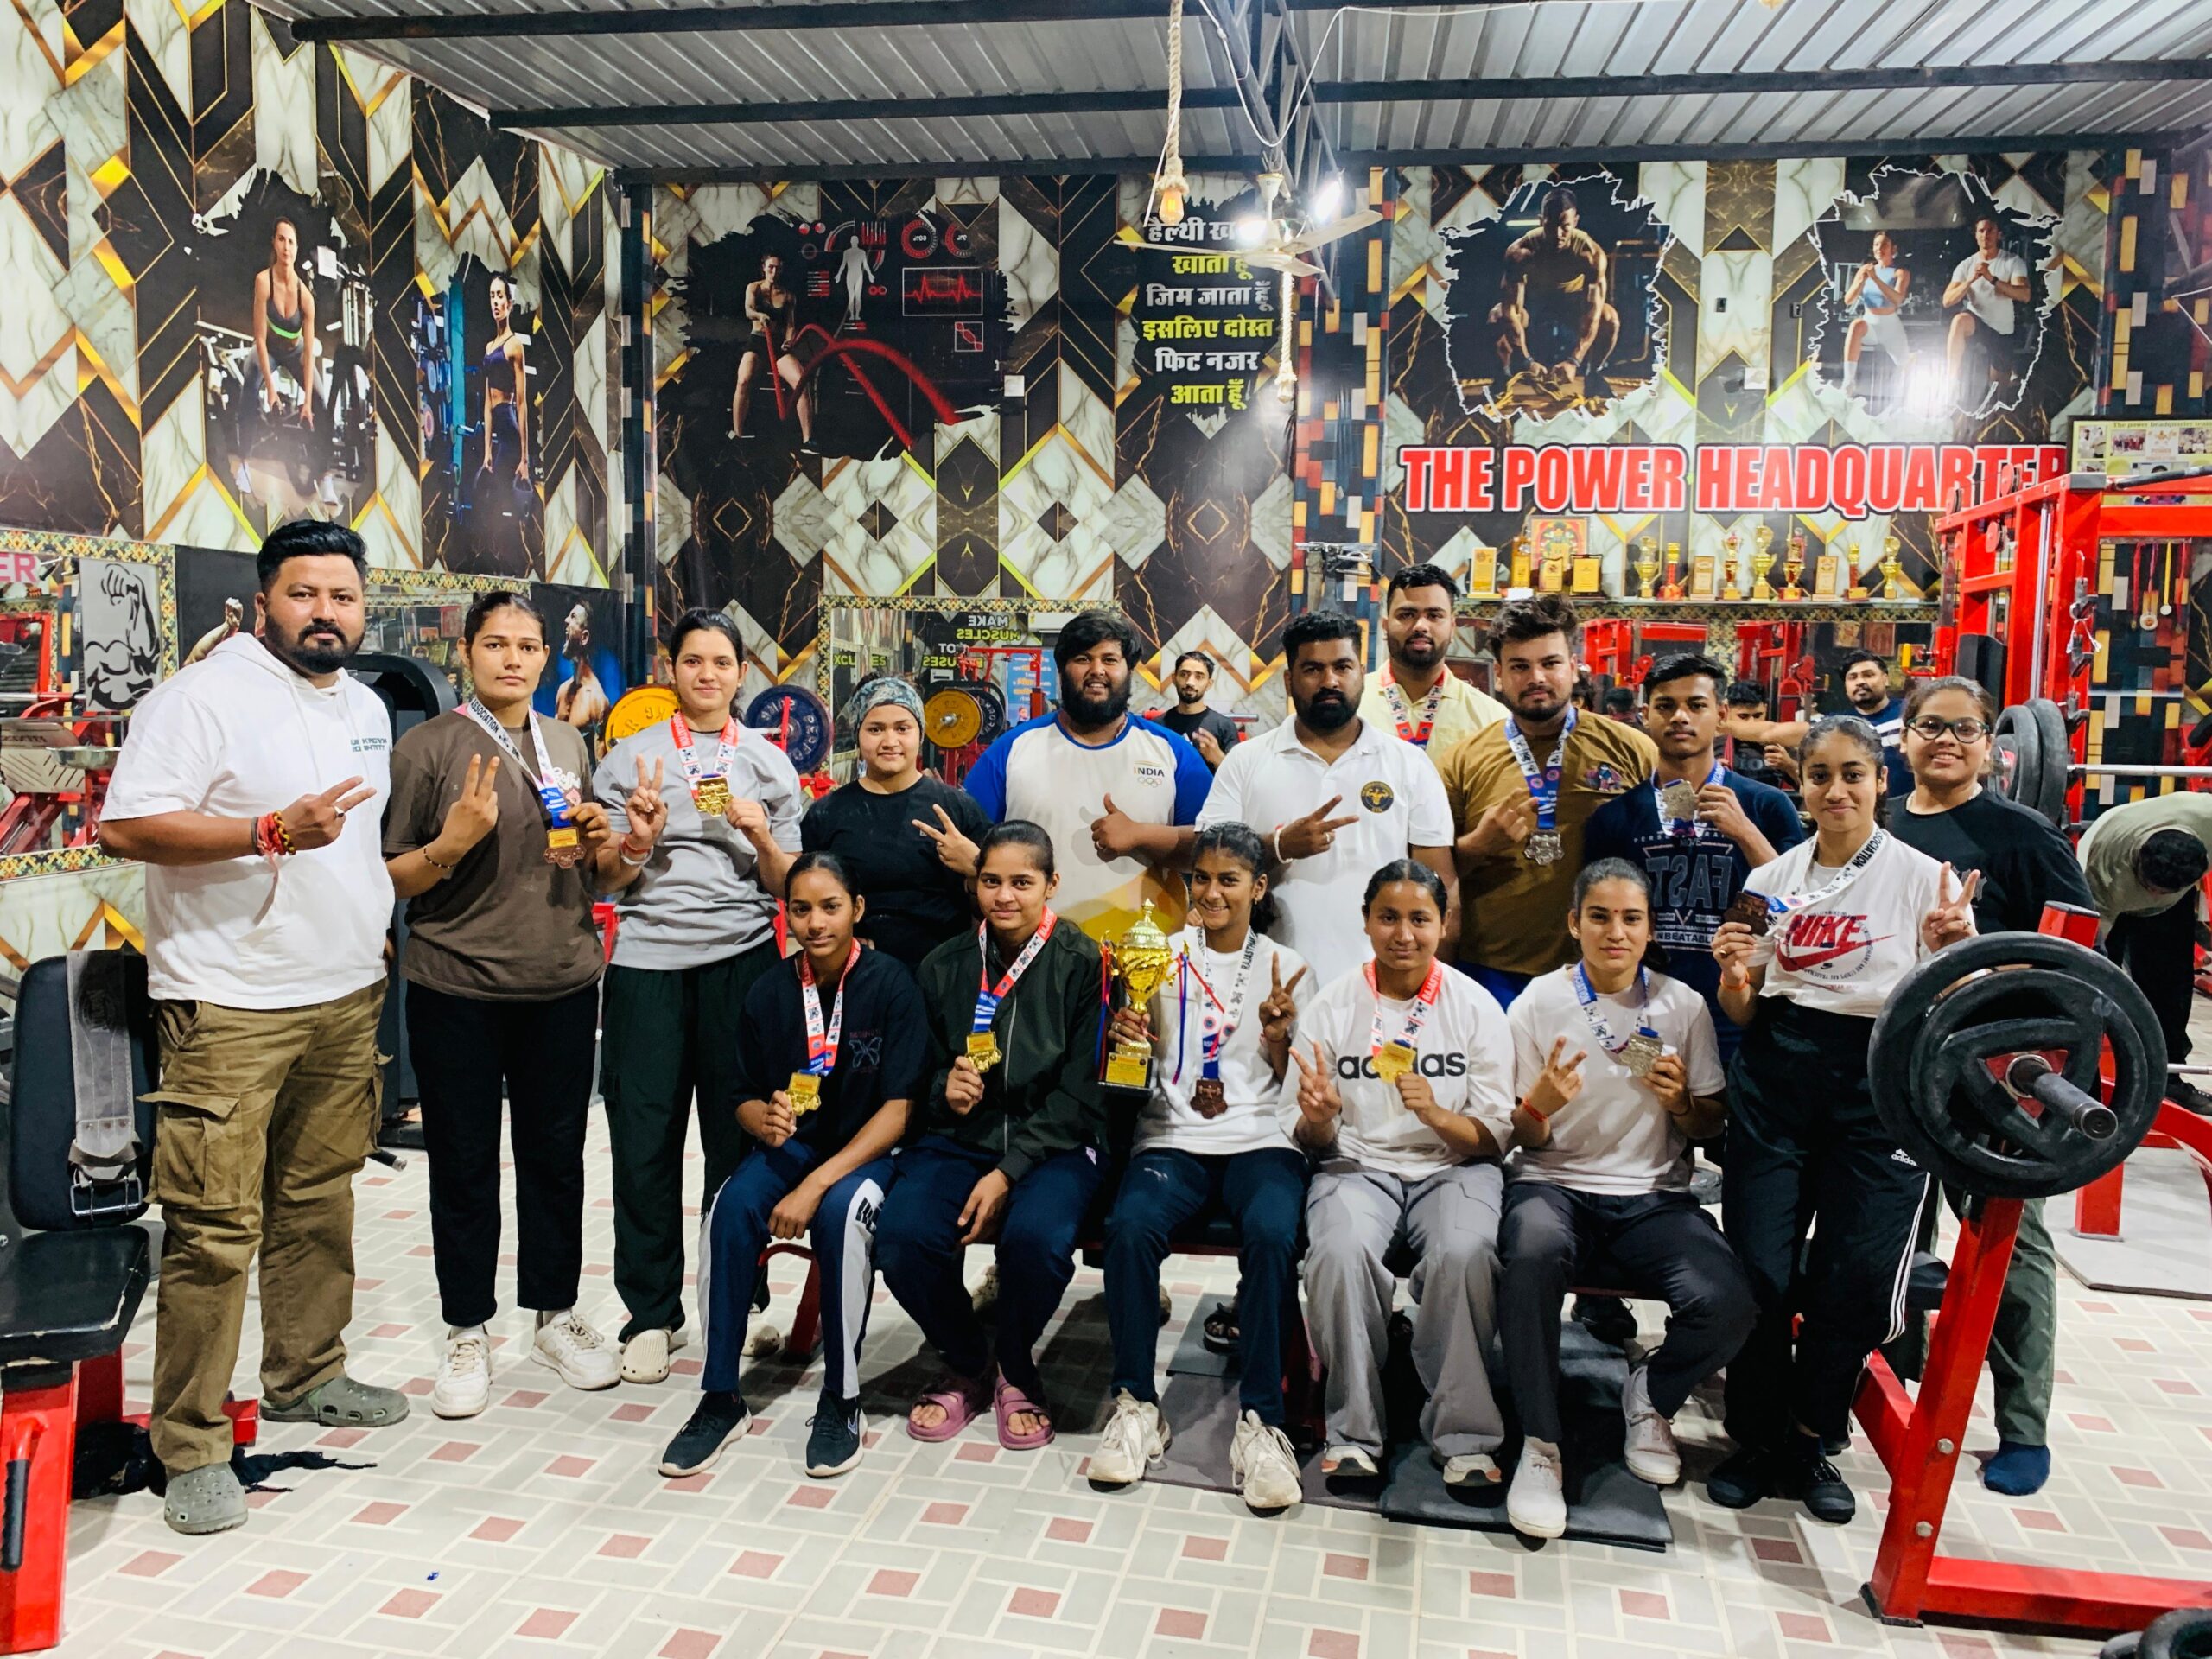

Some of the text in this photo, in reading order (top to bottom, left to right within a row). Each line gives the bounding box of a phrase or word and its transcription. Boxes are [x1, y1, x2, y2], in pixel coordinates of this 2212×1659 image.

[1146, 283, 1194, 307] जिम
[1198, 286, 1252, 306] जाता
[1141, 313, 1274, 339] इसलिए दोस्त
[1155, 346, 1260, 372] फिट नजर
[1171, 384, 1224, 404] आता
[1400, 447, 1495, 512] THE
[1502, 445, 1686, 512] POWER
[1134, 766, 1165, 778] INDIA
[1656, 932, 1715, 944] NBEATABL
[1337, 1046, 1467, 1080] aas
